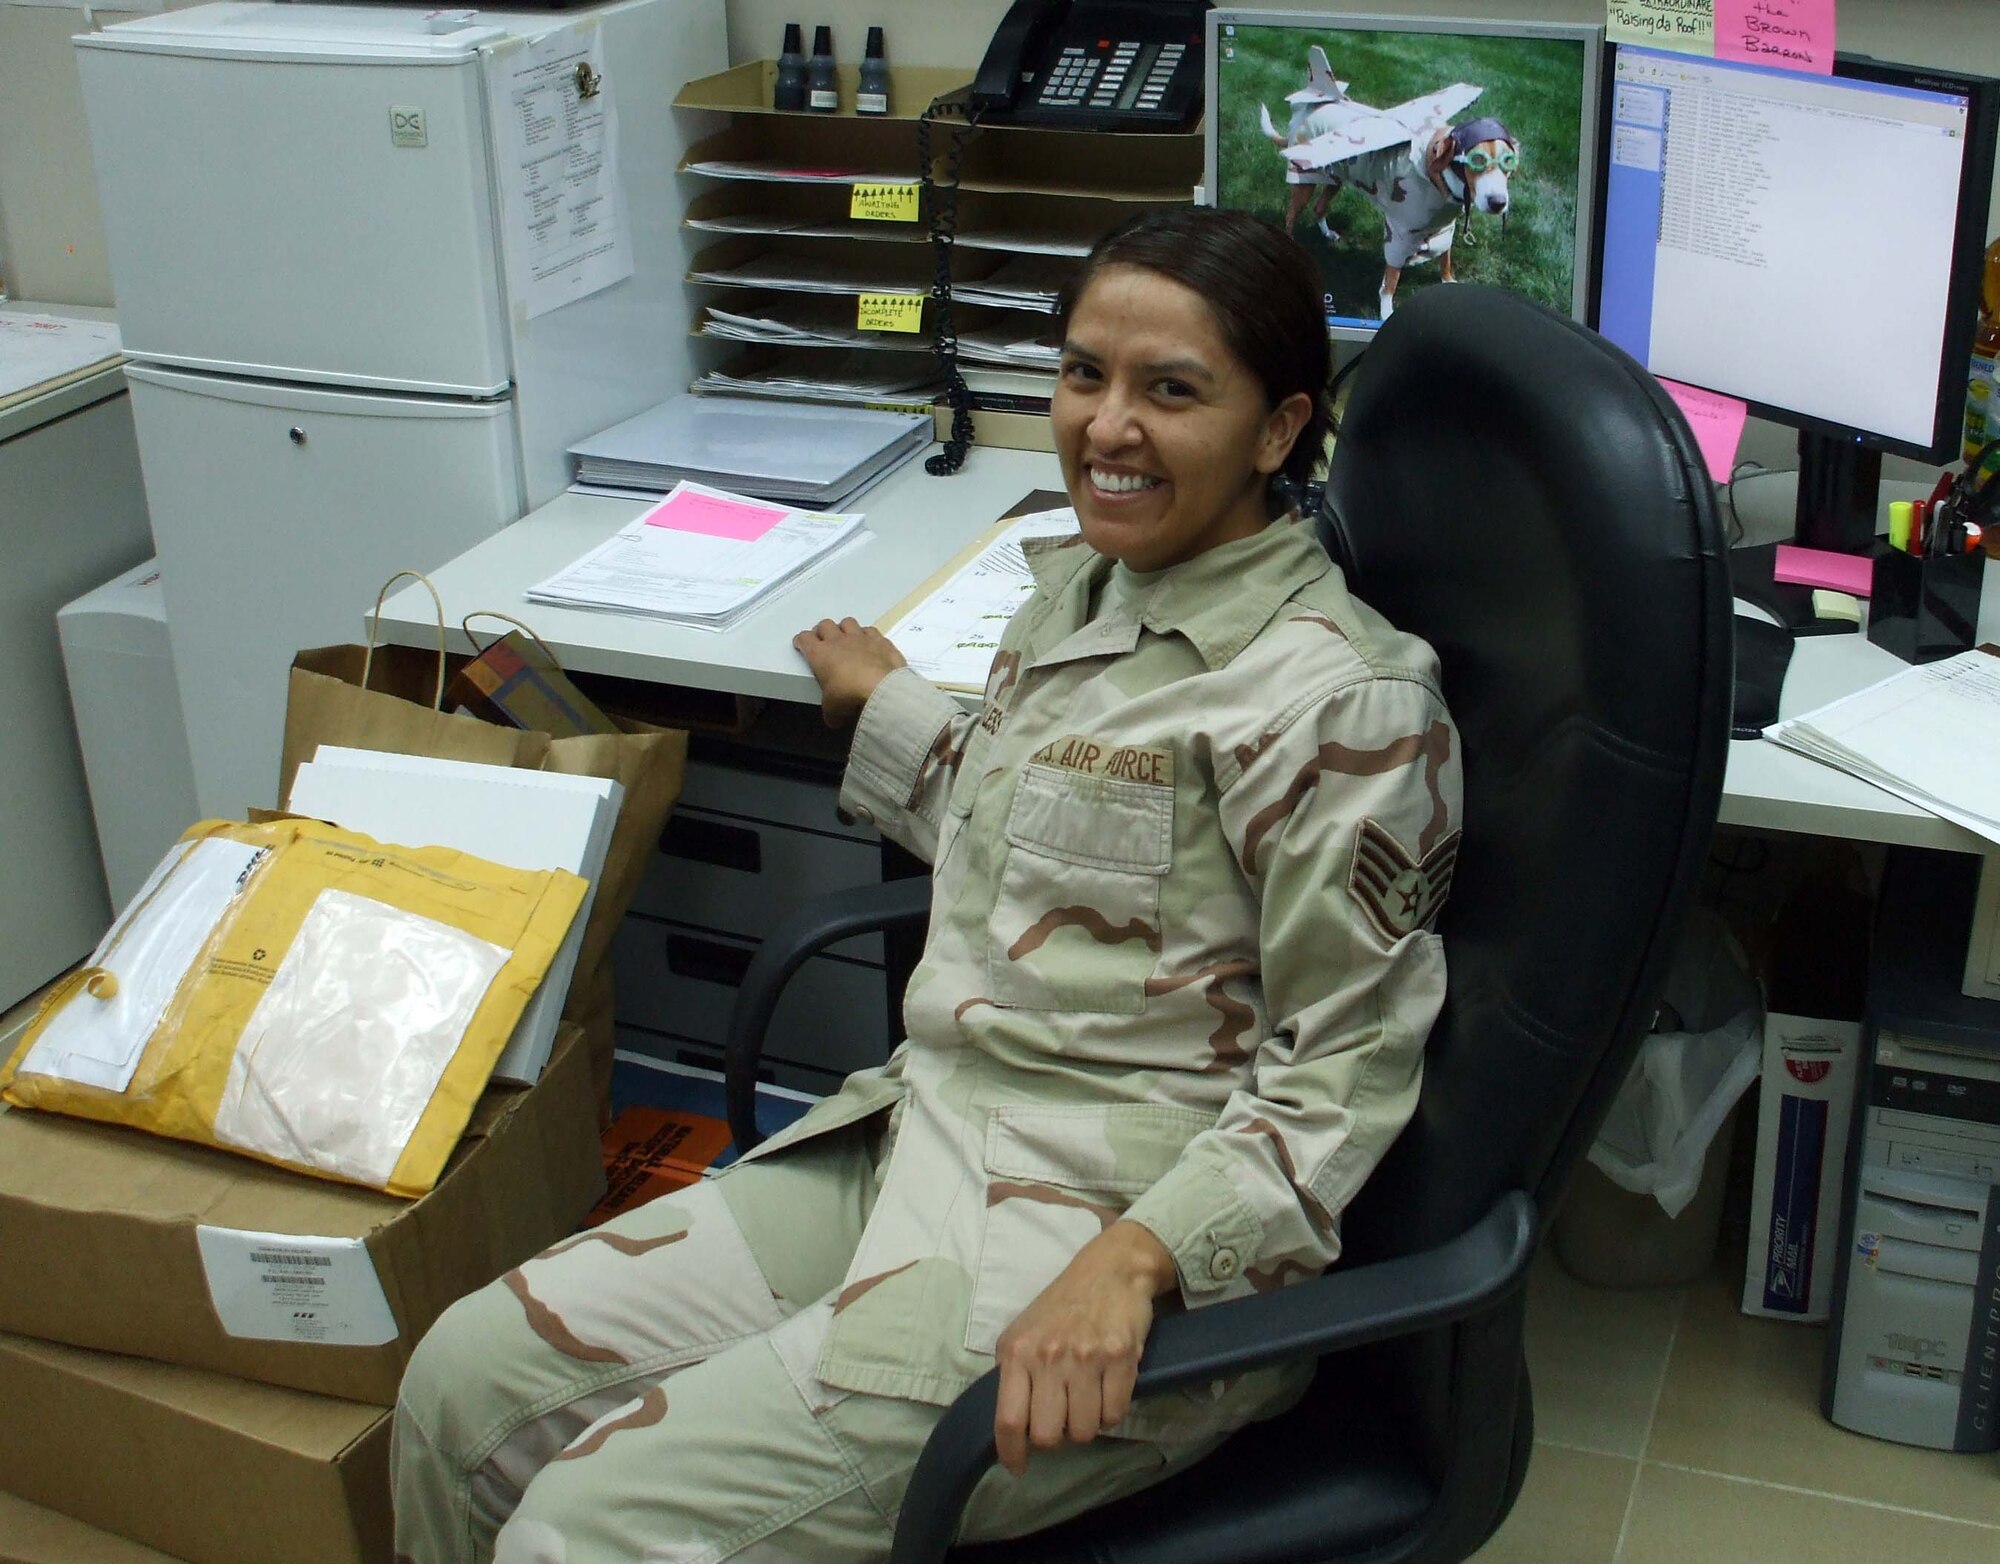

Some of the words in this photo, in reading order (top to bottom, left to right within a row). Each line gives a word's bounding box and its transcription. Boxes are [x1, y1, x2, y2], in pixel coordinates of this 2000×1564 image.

[1656, 14, 1671, 32] da
[865, 209, 897, 219] ORDERS
[865, 318, 895, 328] ORDERS
[1060, 739, 1102, 774] AIR
[1772, 1212, 1788, 1265] PRIORITY
[1786, 1241, 1799, 1270] MAIL
